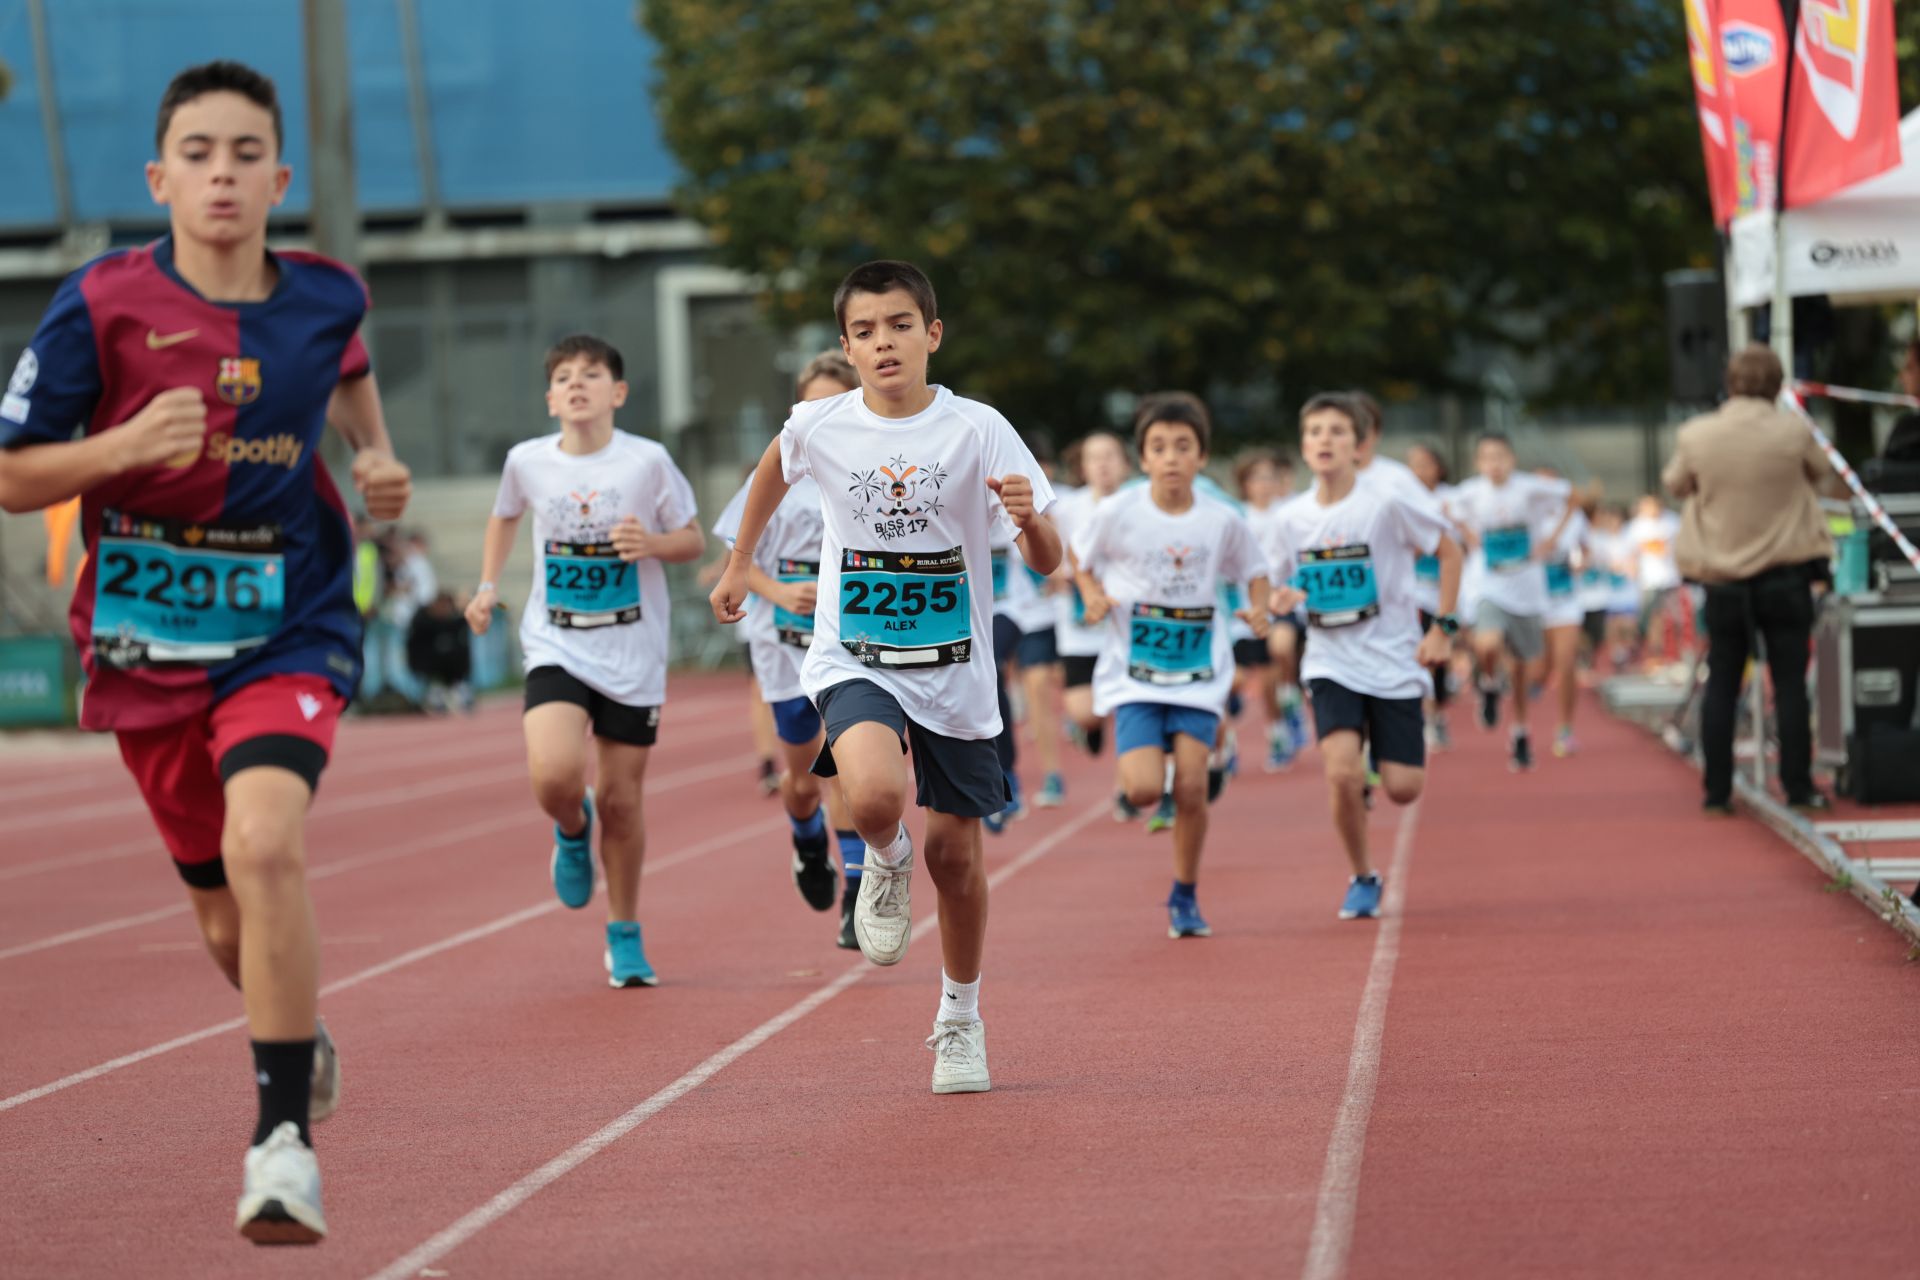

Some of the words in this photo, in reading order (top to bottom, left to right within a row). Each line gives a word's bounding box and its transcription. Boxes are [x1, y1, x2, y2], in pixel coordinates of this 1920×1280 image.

[206, 431, 303, 469] Spotify
[907, 518, 929, 534] 17
[103, 551, 260, 612] 2296
[546, 561, 628, 591] 2297
[1299, 565, 1366, 593] 2149
[842, 580, 958, 617] 2255
[884, 620, 917, 632] ALEX
[1133, 624, 1208, 651] 2217
